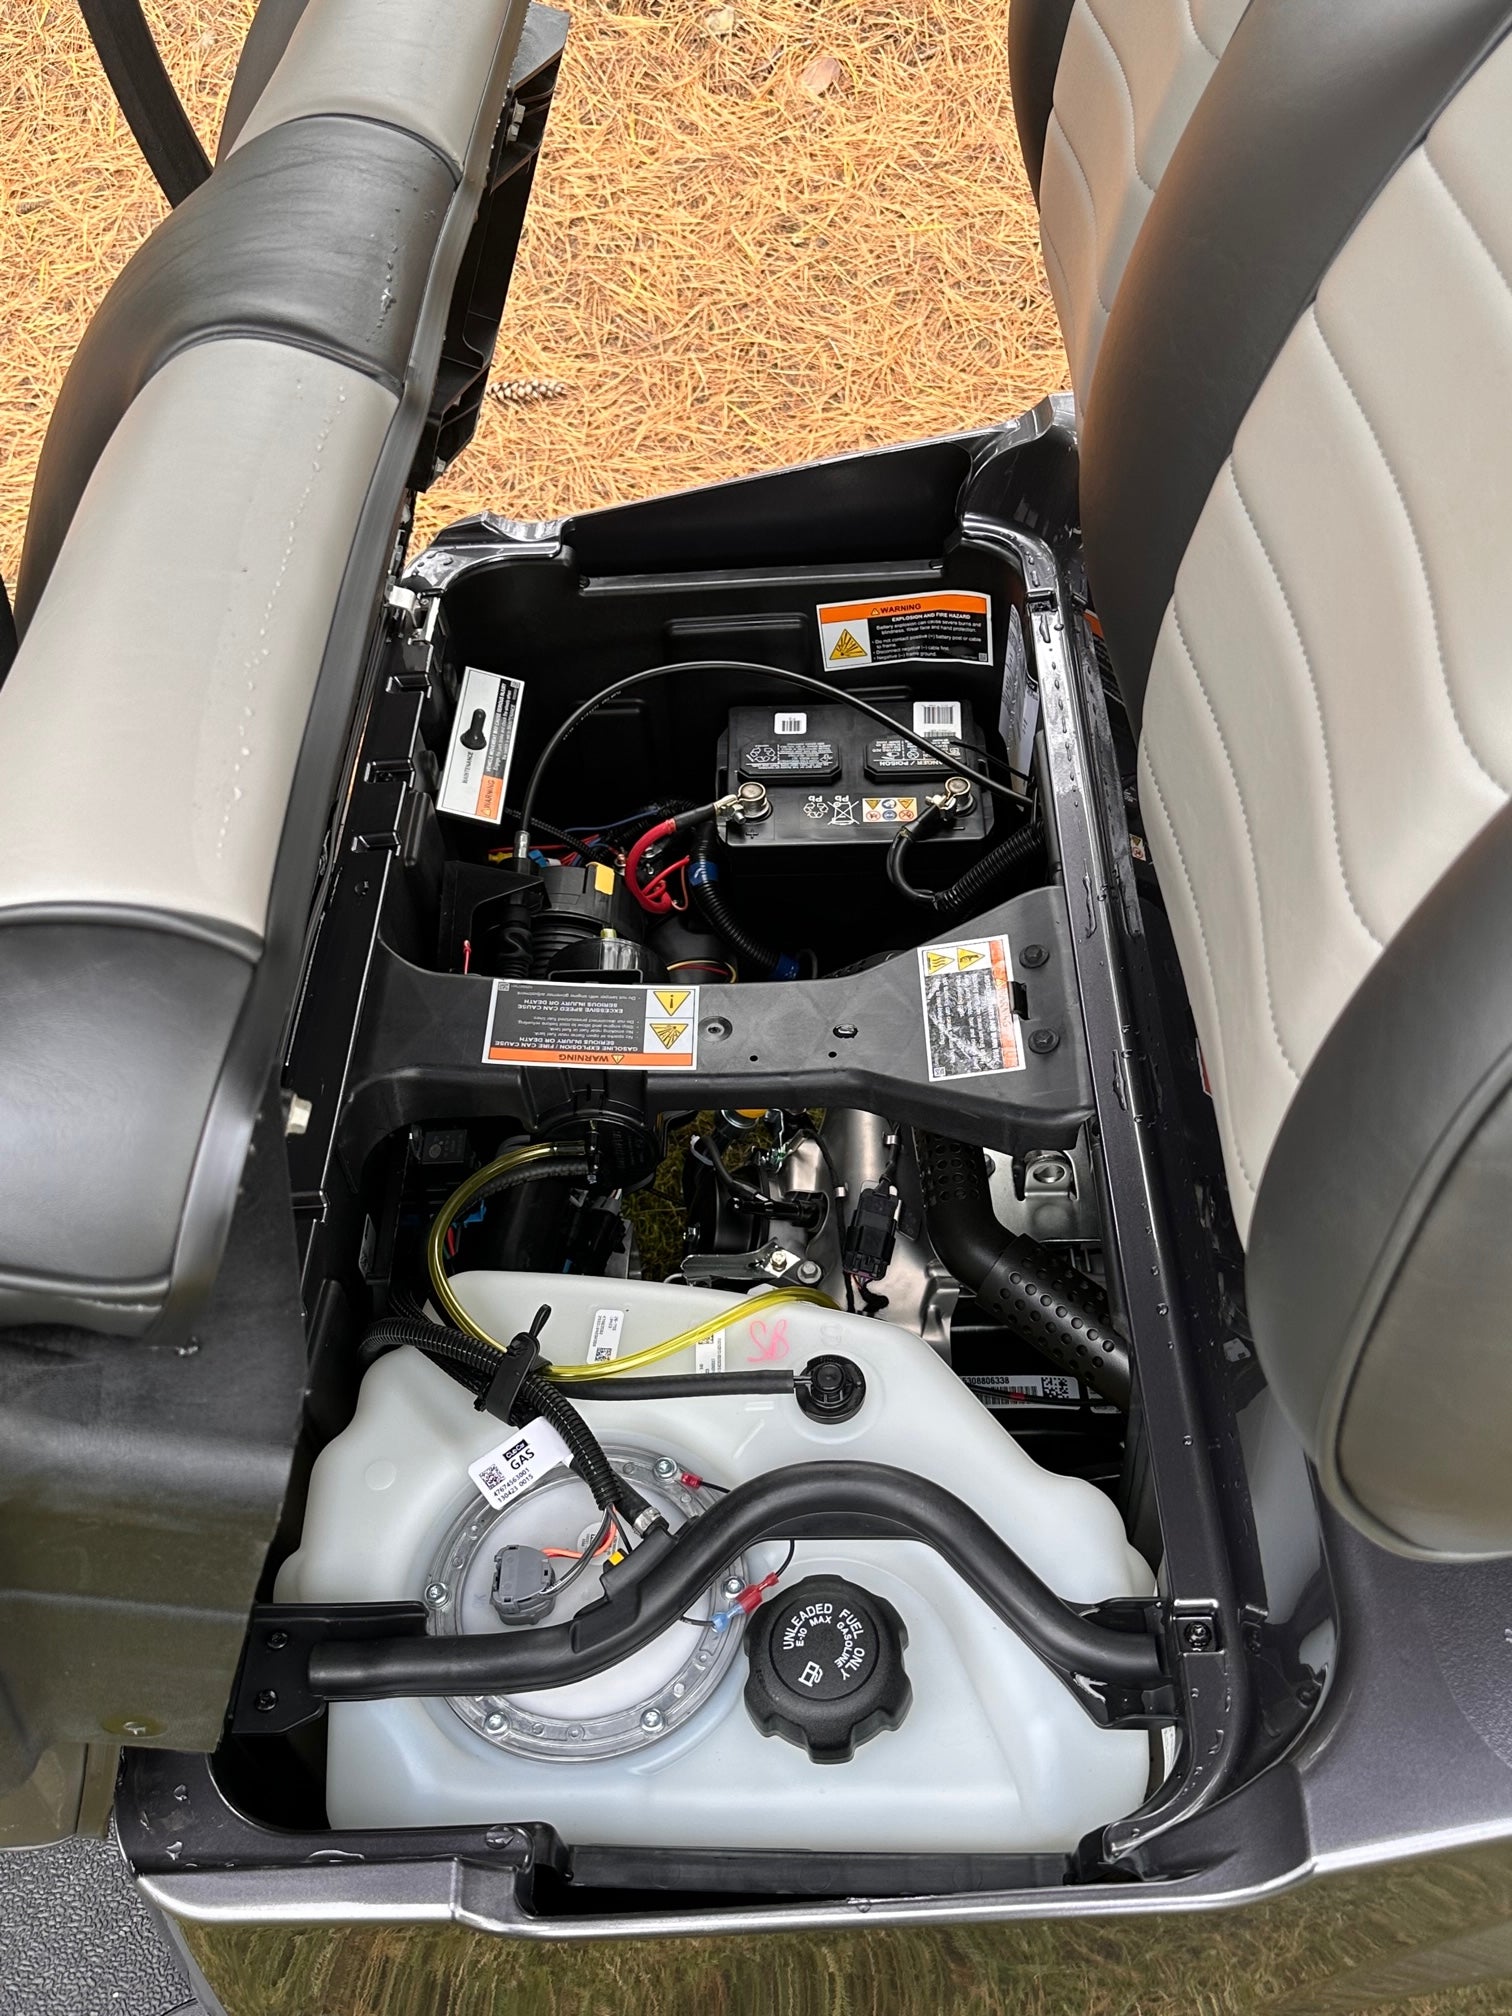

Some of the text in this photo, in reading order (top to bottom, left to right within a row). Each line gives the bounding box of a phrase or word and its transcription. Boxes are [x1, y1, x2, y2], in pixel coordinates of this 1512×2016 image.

[880, 603, 921, 614] WARNING
[892, 614, 922, 622] EXPLOSION
[461, 751, 473, 783] MAINTENANCE
[483, 779, 495, 808] WARNING
[558, 1053, 608, 1062] WARNING
[508, 1447, 535, 1471] GAS
[492, 1466, 530, 1497] 47674563001
[497, 1473, 534, 1502] 130423 0015
[783, 1603, 865, 1680] UNLEADED FUEL ONLY
[796, 1615, 854, 1668] E-10 MAX GASOLINE
